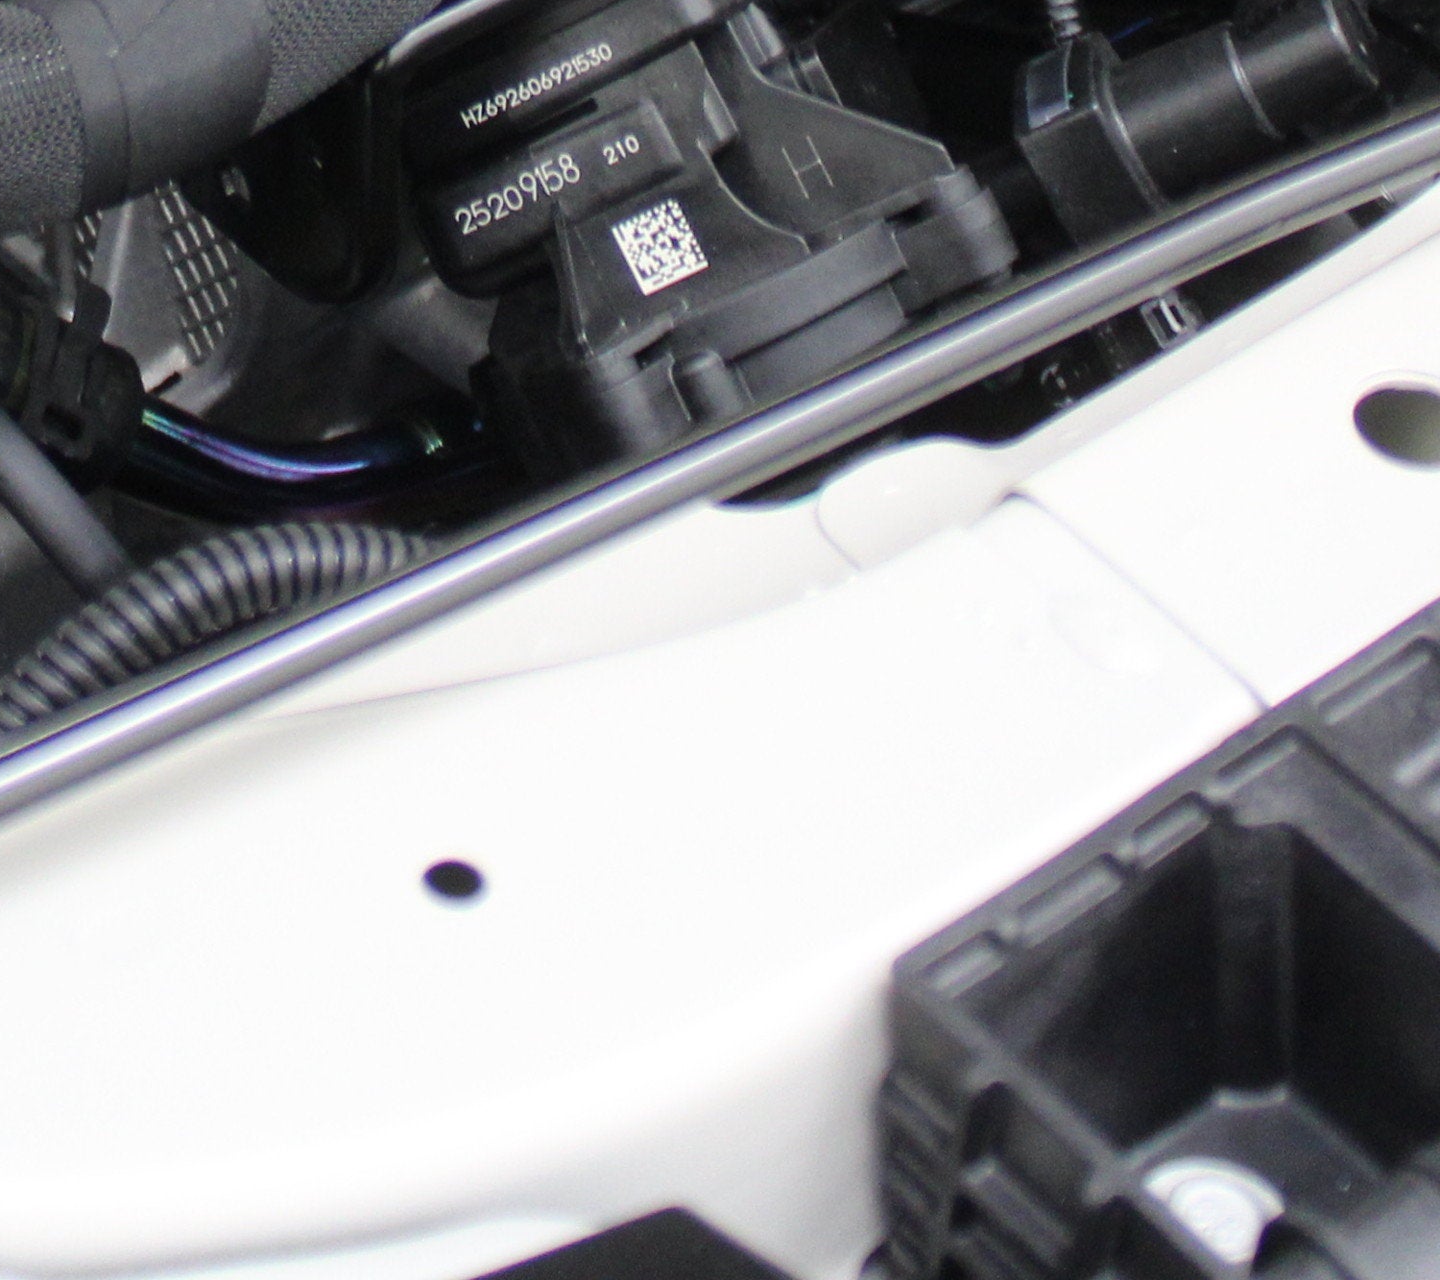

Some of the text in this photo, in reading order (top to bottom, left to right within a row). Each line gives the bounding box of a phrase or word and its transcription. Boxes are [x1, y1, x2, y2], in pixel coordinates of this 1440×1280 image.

[459, 42, 613, 129] HZ692606921530
[454, 134, 640, 236] 25209158 210
